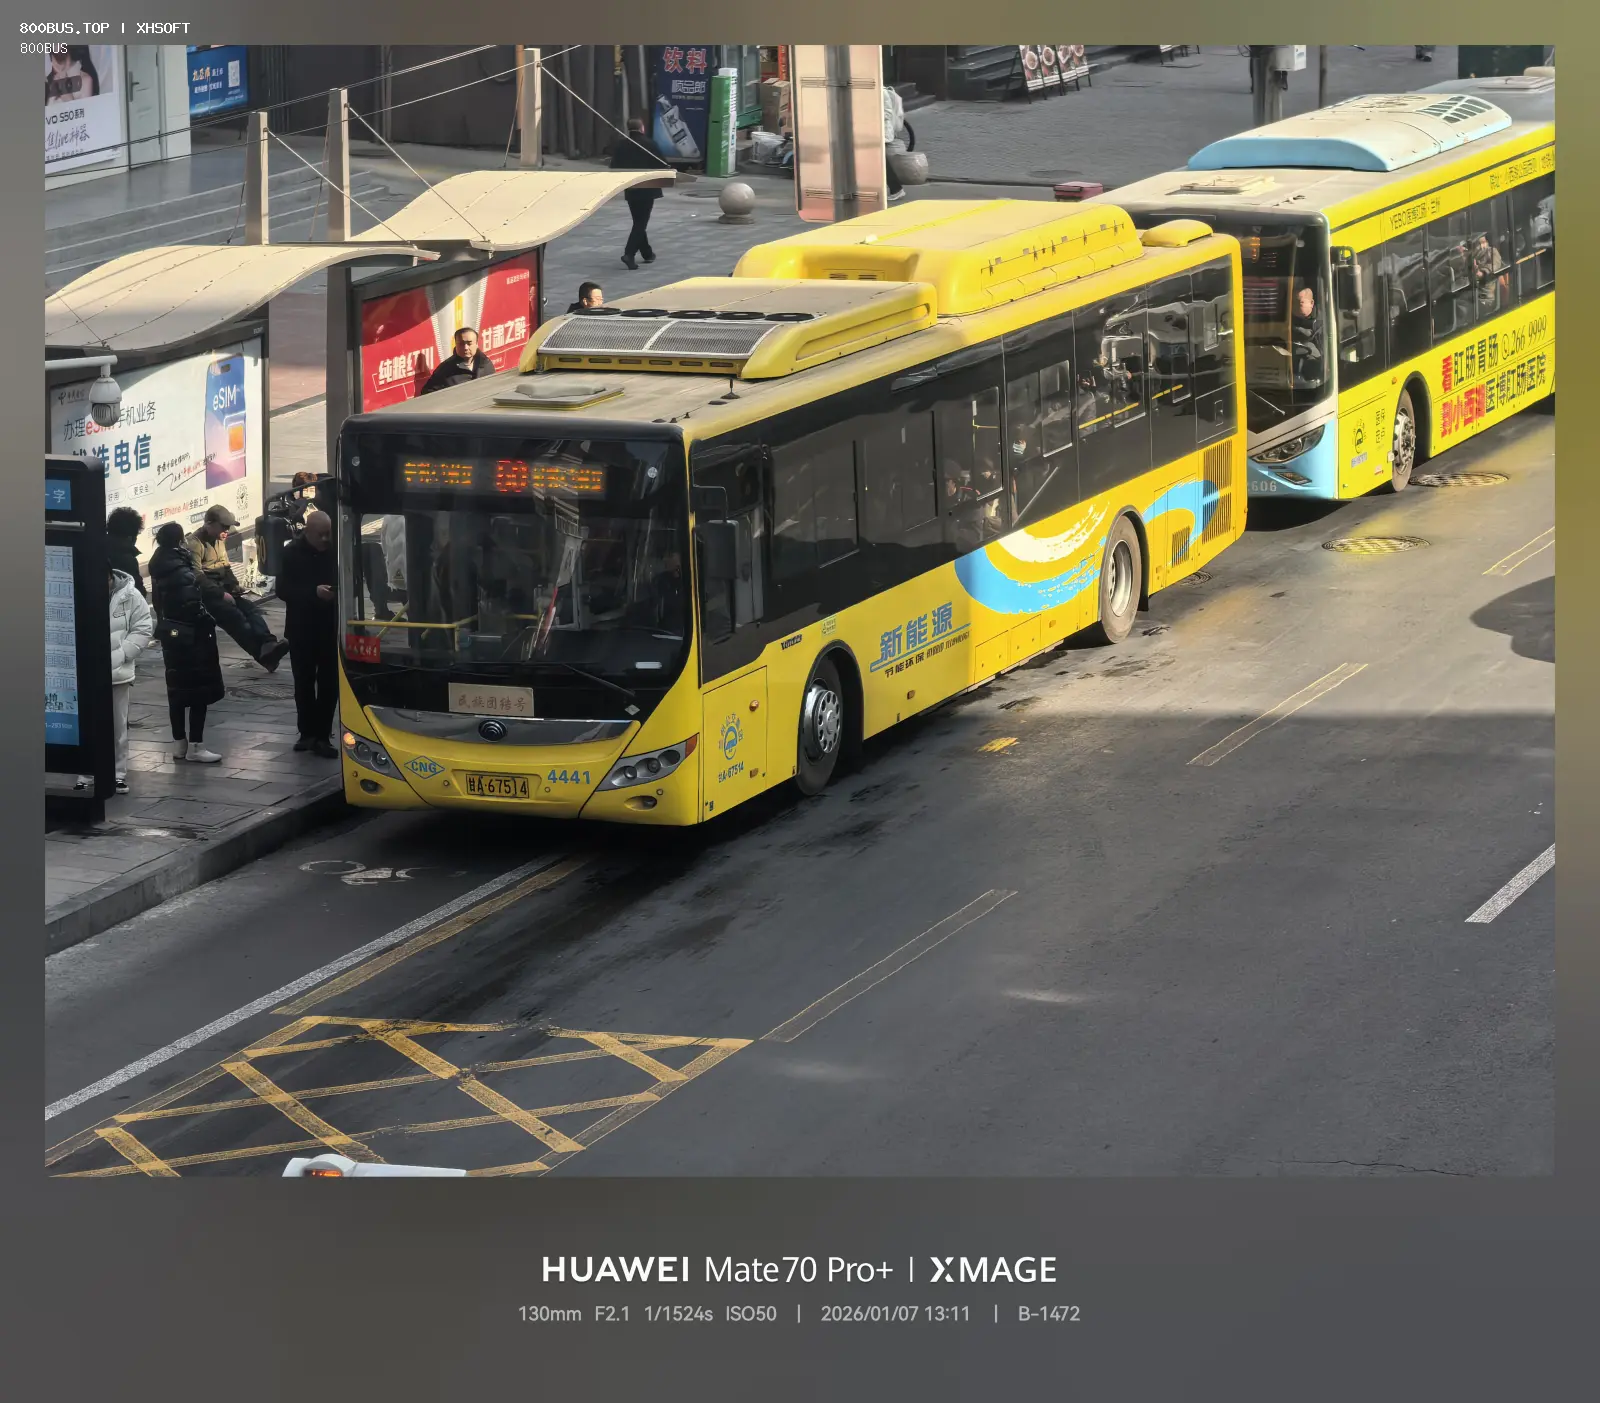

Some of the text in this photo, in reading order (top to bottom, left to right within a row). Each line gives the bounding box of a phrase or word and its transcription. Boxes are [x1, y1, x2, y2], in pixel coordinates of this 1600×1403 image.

[663, 47, 708, 74] 饮料
[59, 108, 85, 123] S50系列
[481, 316, 527, 352] 甘肃之醉
[1510, 325, 1526, 356] 266
[1528, 315, 1547, 347] 9999
[212, 388, 238, 411] eSIM
[1248, 480, 1277, 492] 606
[879, 601, 953, 662] 新能源
[885, 652, 925, 678] 节能环保
[458, 694, 527, 712] 民族团结号
[411, 760, 438, 774] CNG
[547, 769, 591, 785] 4441
